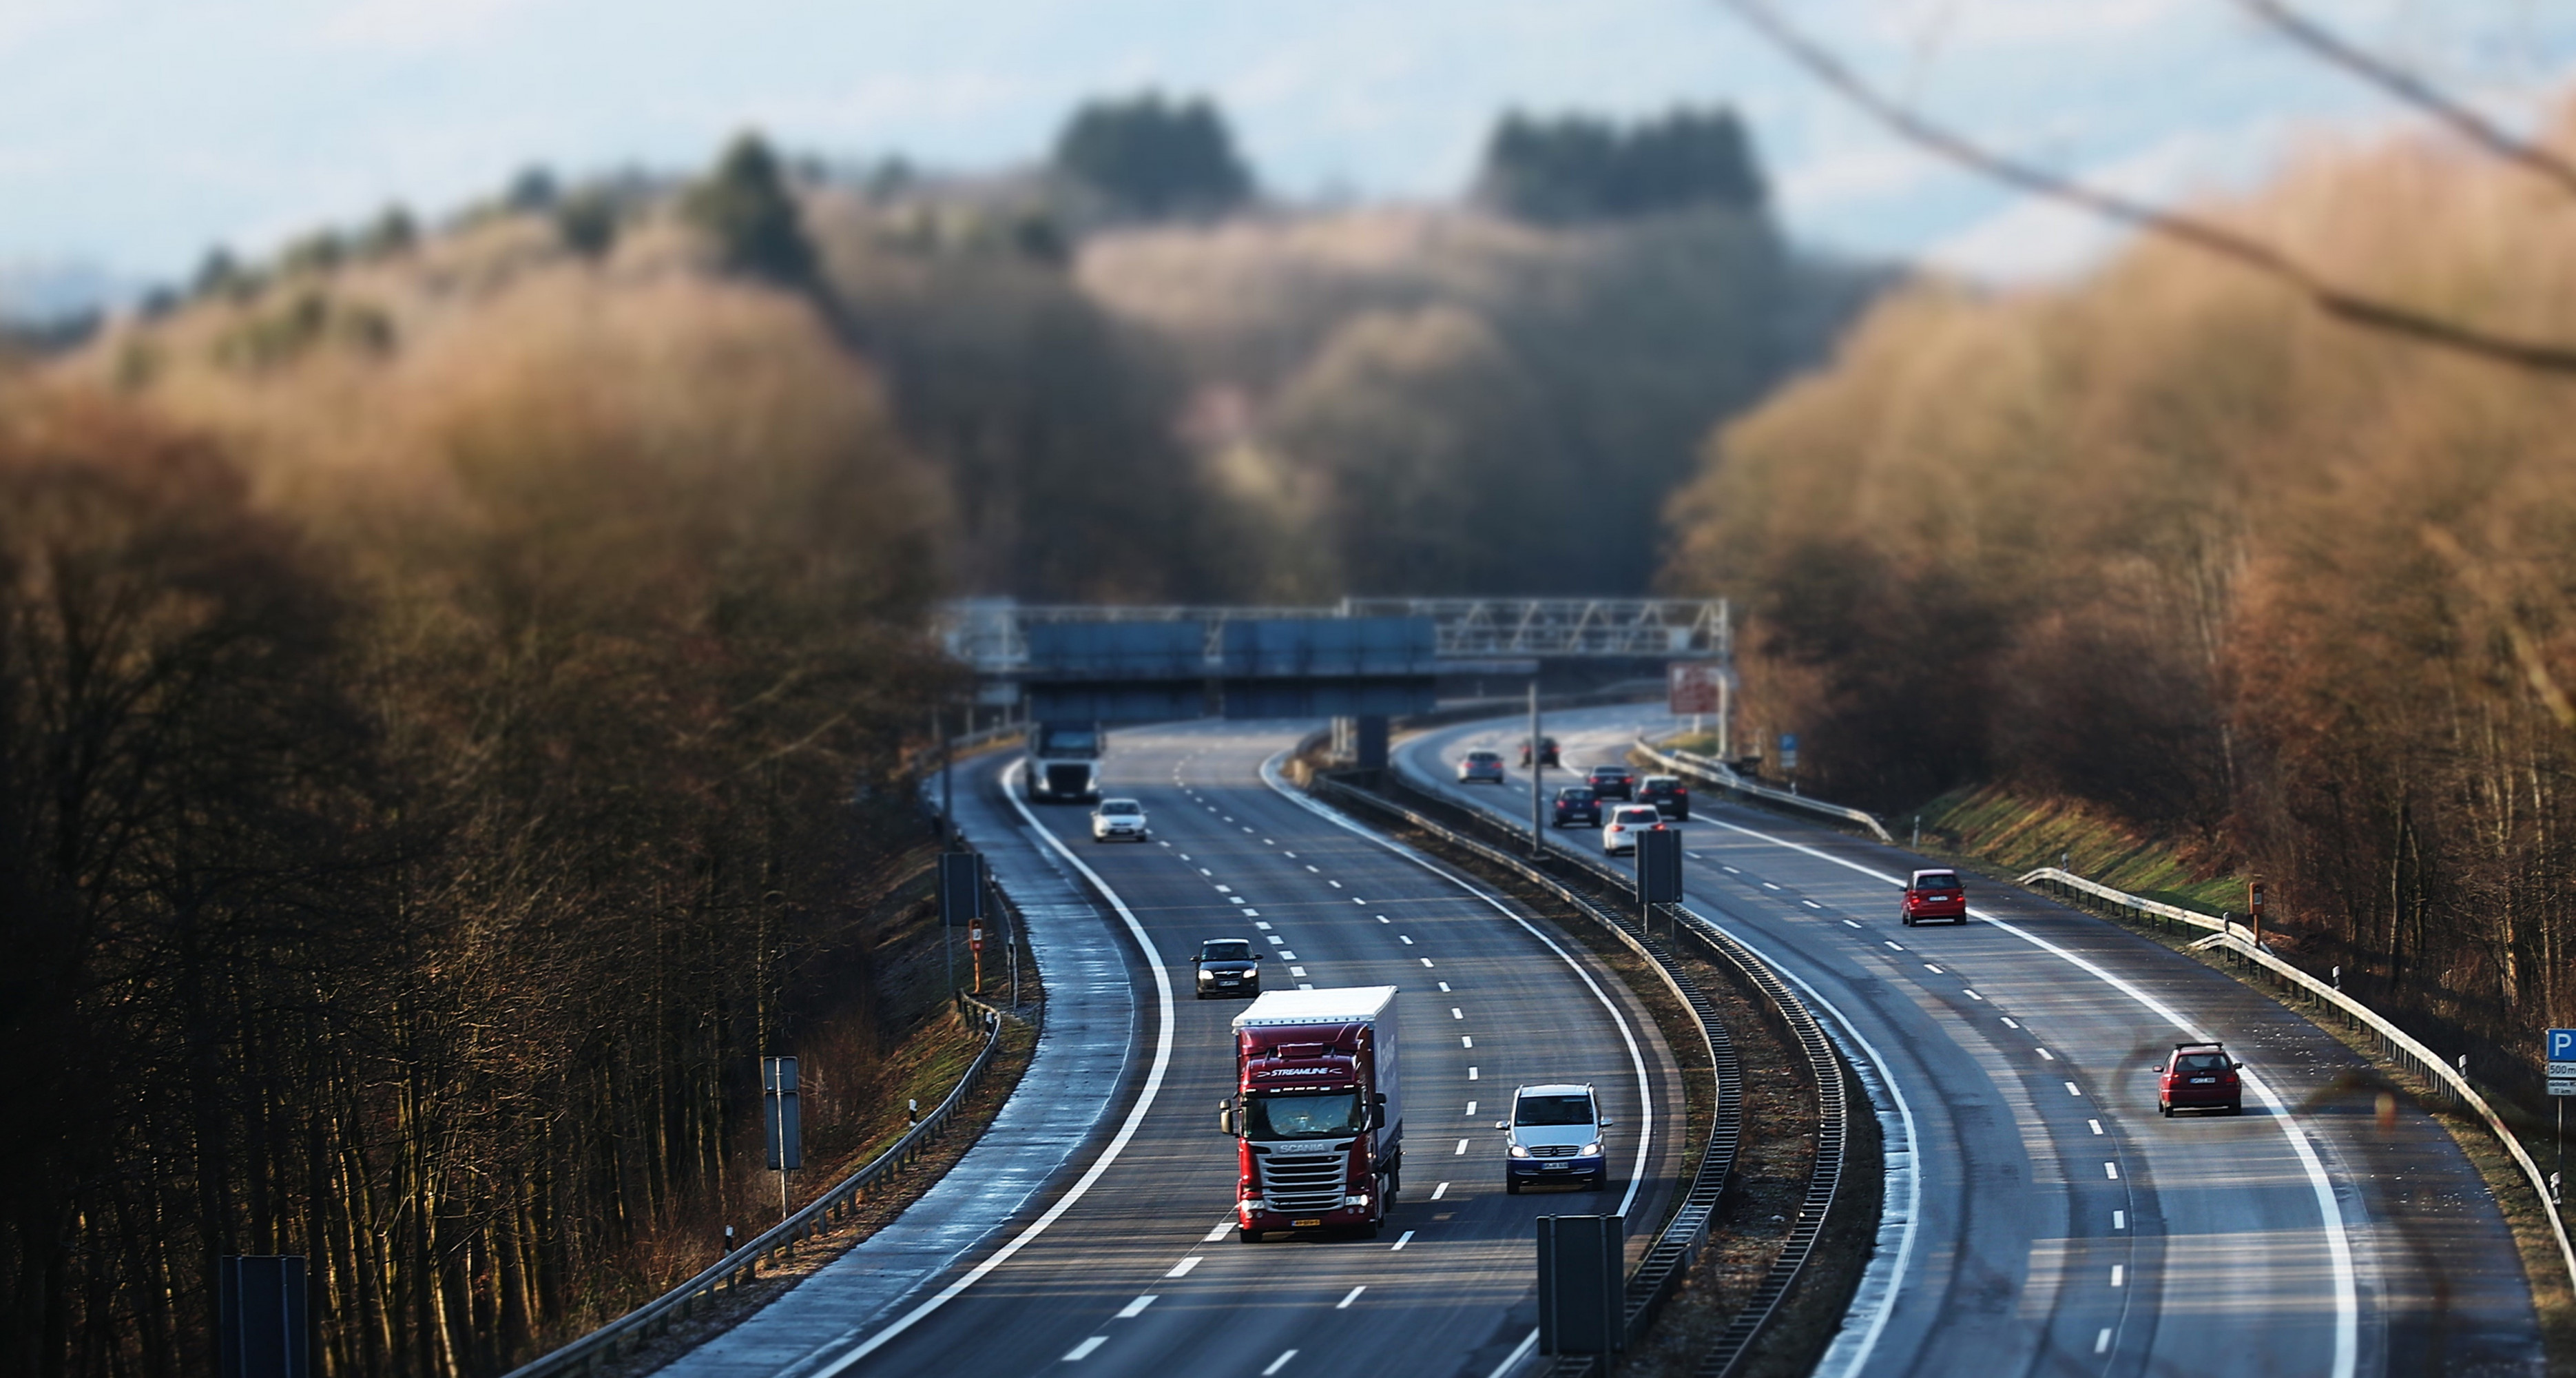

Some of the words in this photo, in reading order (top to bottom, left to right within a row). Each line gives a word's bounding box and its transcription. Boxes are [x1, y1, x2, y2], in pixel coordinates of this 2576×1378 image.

[2555, 1033, 2572, 1056] P
[1270, 1067, 1329, 1077] STREAMLINE
[1280, 1143, 1325, 1153] SCANIA
